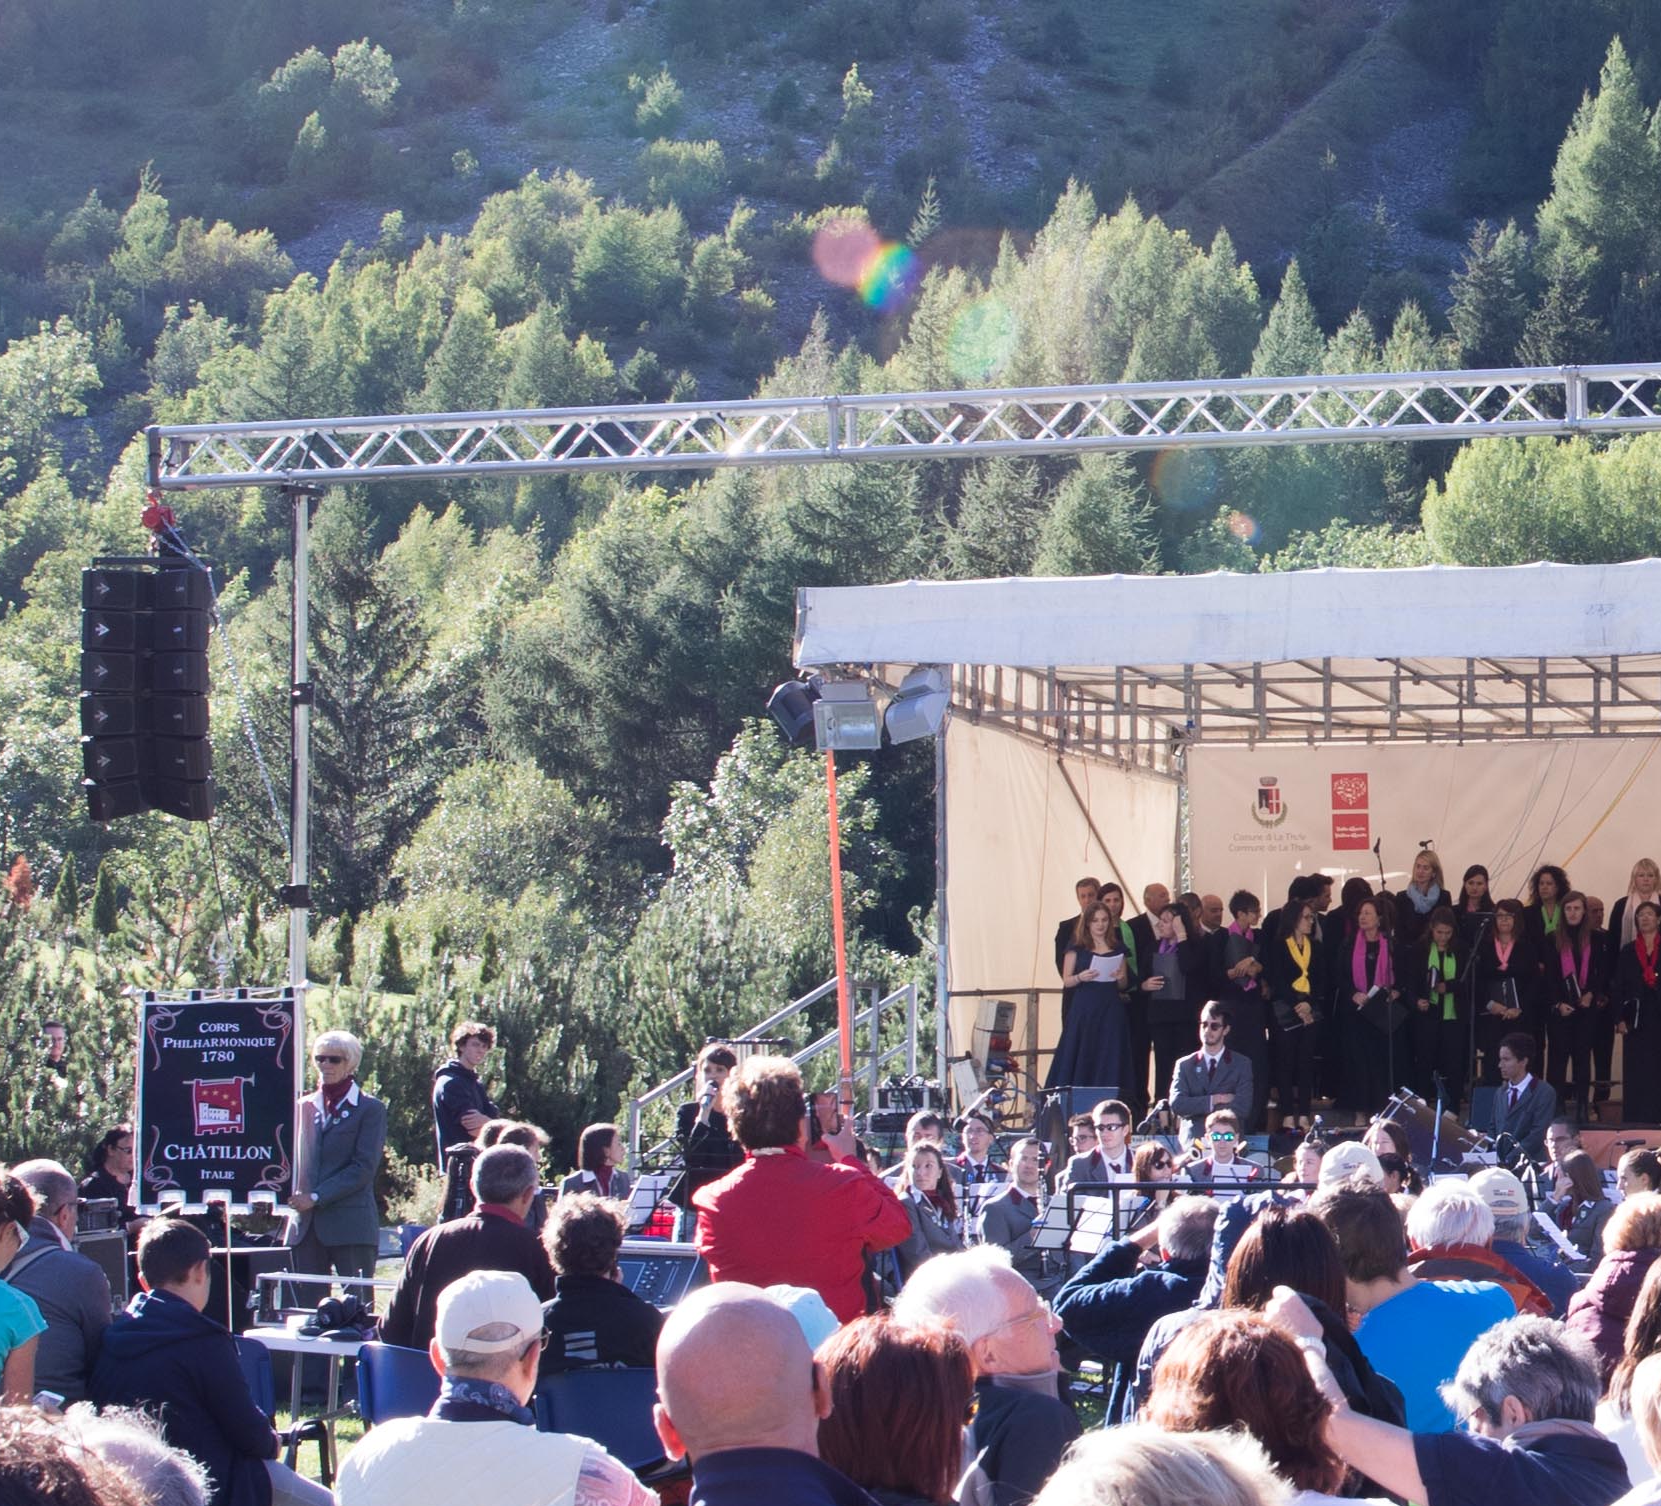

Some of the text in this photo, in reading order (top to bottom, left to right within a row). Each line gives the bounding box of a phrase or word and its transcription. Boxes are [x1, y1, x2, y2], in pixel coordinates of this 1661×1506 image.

[199, 1022, 240, 1033] CORPS
[163, 1037, 276, 1048] PHILHARMONIQUE
[201, 1051, 235, 1063] 1780
[163, 1144, 272, 1160] CHÂTILLON
[200, 1169, 235, 1180] ITALIE
